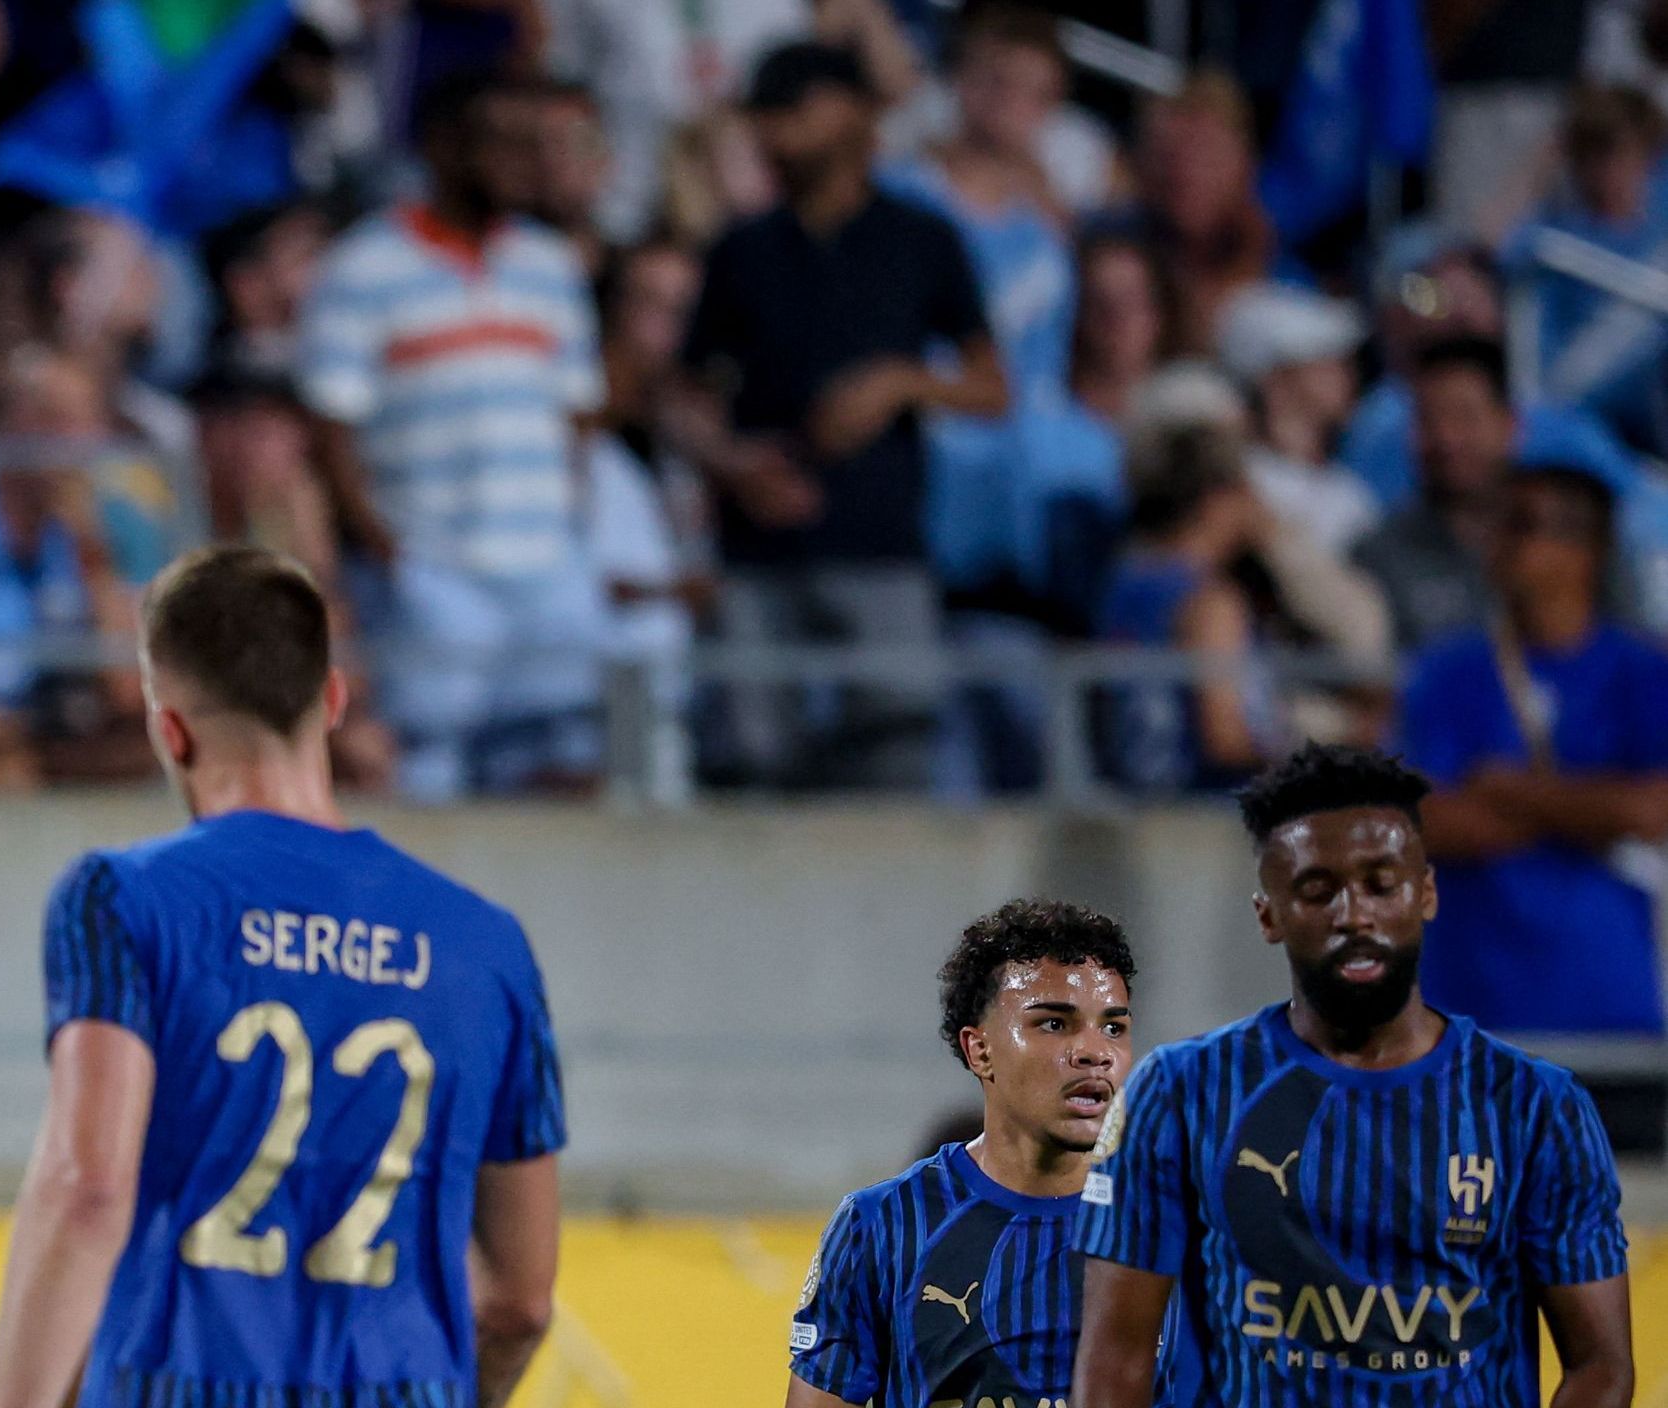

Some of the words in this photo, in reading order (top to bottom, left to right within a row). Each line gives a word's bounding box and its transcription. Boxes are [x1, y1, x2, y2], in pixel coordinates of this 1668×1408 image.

[240, 908, 432, 990] SERGEJ
[179, 1000, 435, 1289] 22
[1241, 1279, 1482, 1343] SAVVY
[1263, 1348, 1351, 1370] AMES
[1368, 1349, 1472, 1369] GROUP
